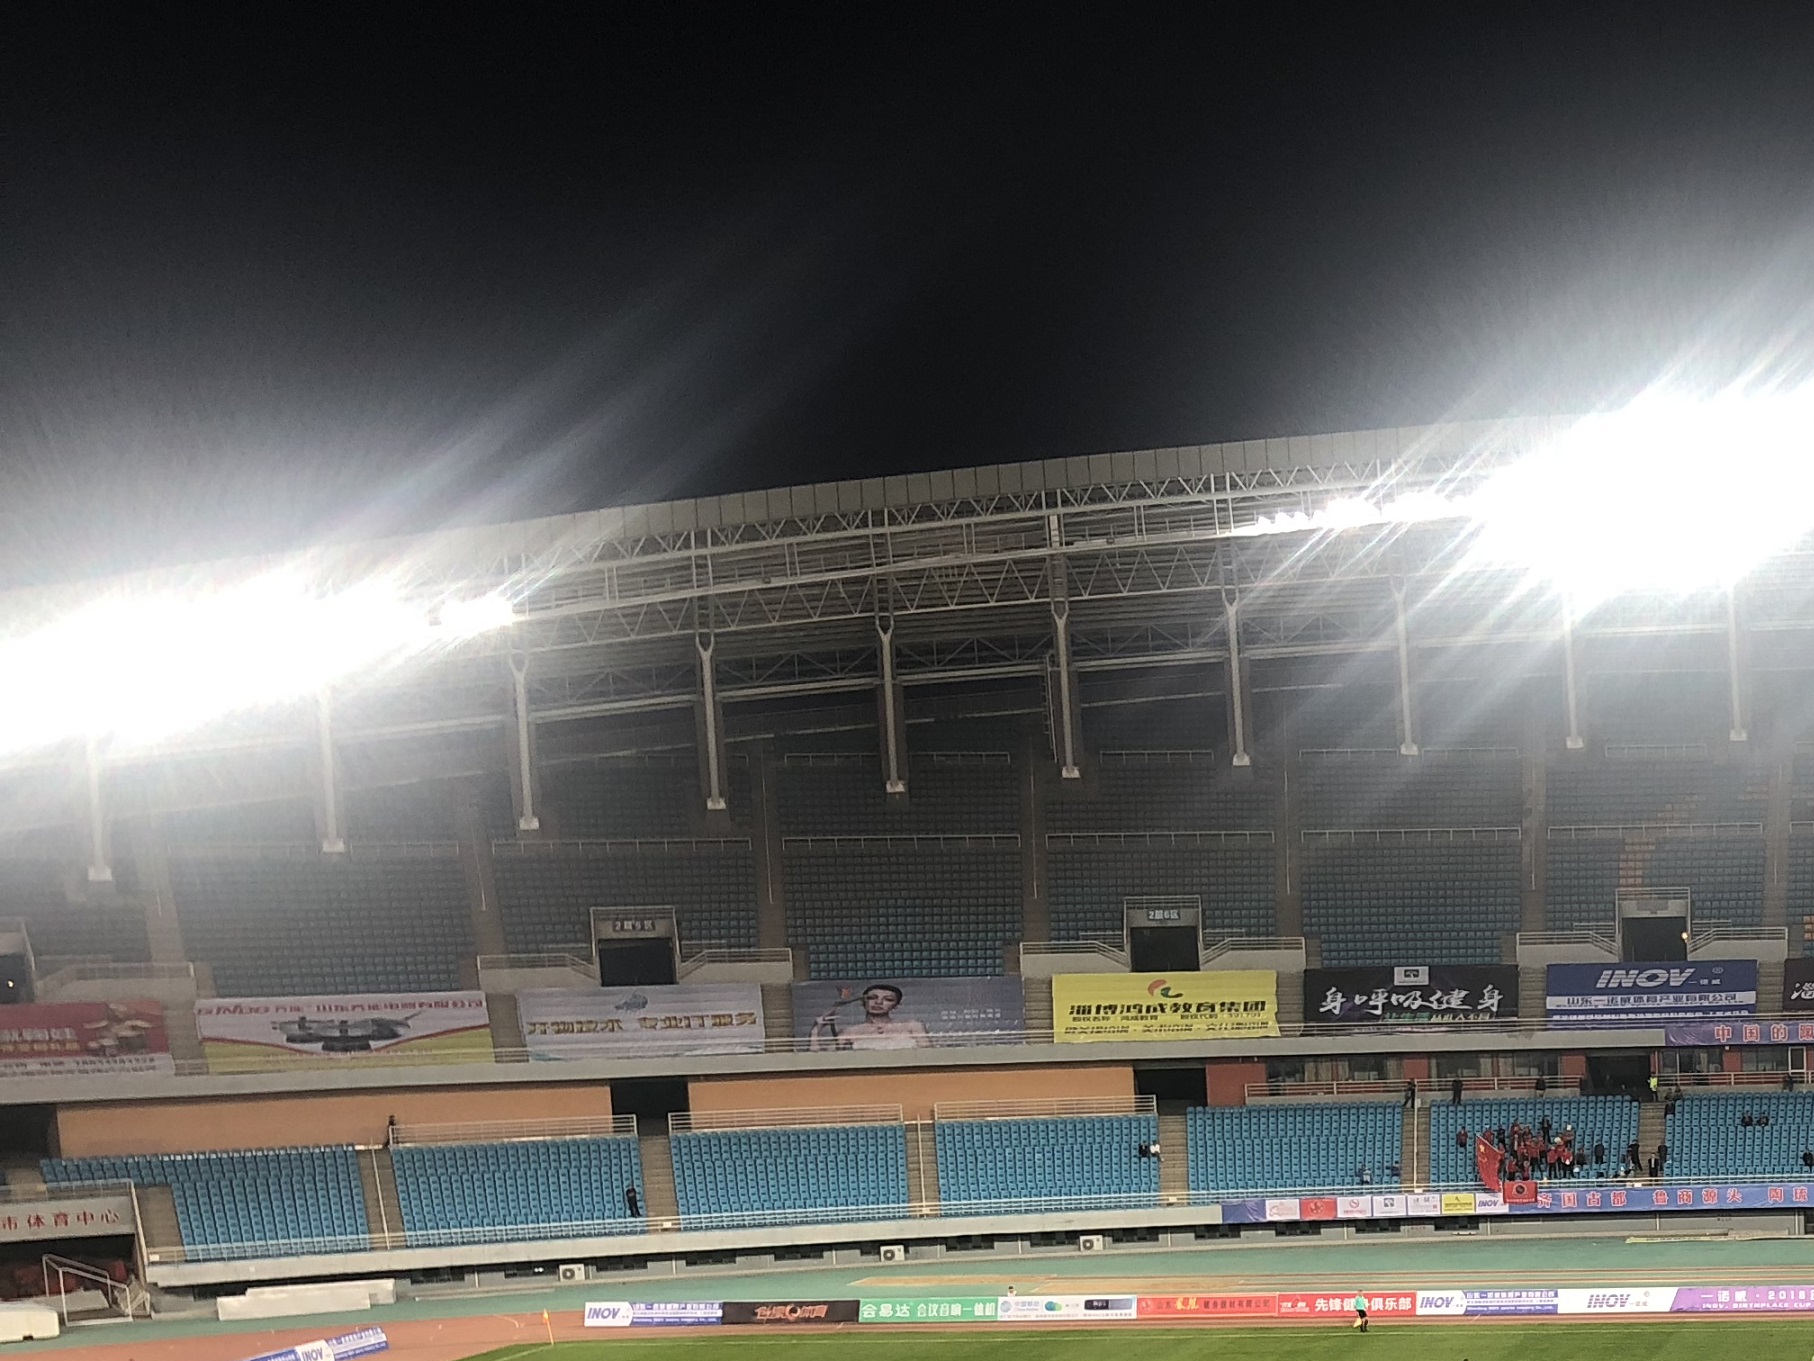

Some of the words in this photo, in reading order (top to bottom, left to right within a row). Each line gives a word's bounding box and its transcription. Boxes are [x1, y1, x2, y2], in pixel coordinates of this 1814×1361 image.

[1595, 967, 1696, 988] INOV
[1068, 1000, 1267, 1015] 淄博鸿成教育集团
[526, 1018, 624, 1036] 开物技术
[636, 1012, 758, 1031] 专业IT服务
[1537, 1189, 1628, 1208] 齐国古都
[1653, 1187, 1743, 1205] 鲁商源头
[2, 1208, 120, 1232] 市体育中心
[1314, 1296, 1413, 1311] 先锋健俱乐部
[1419, 1296, 1455, 1308] INOV
[1587, 1293, 1631, 1308] INOV
[586, 1307, 621, 1320] INOV
[861, 1302, 911, 1318] 会易达
